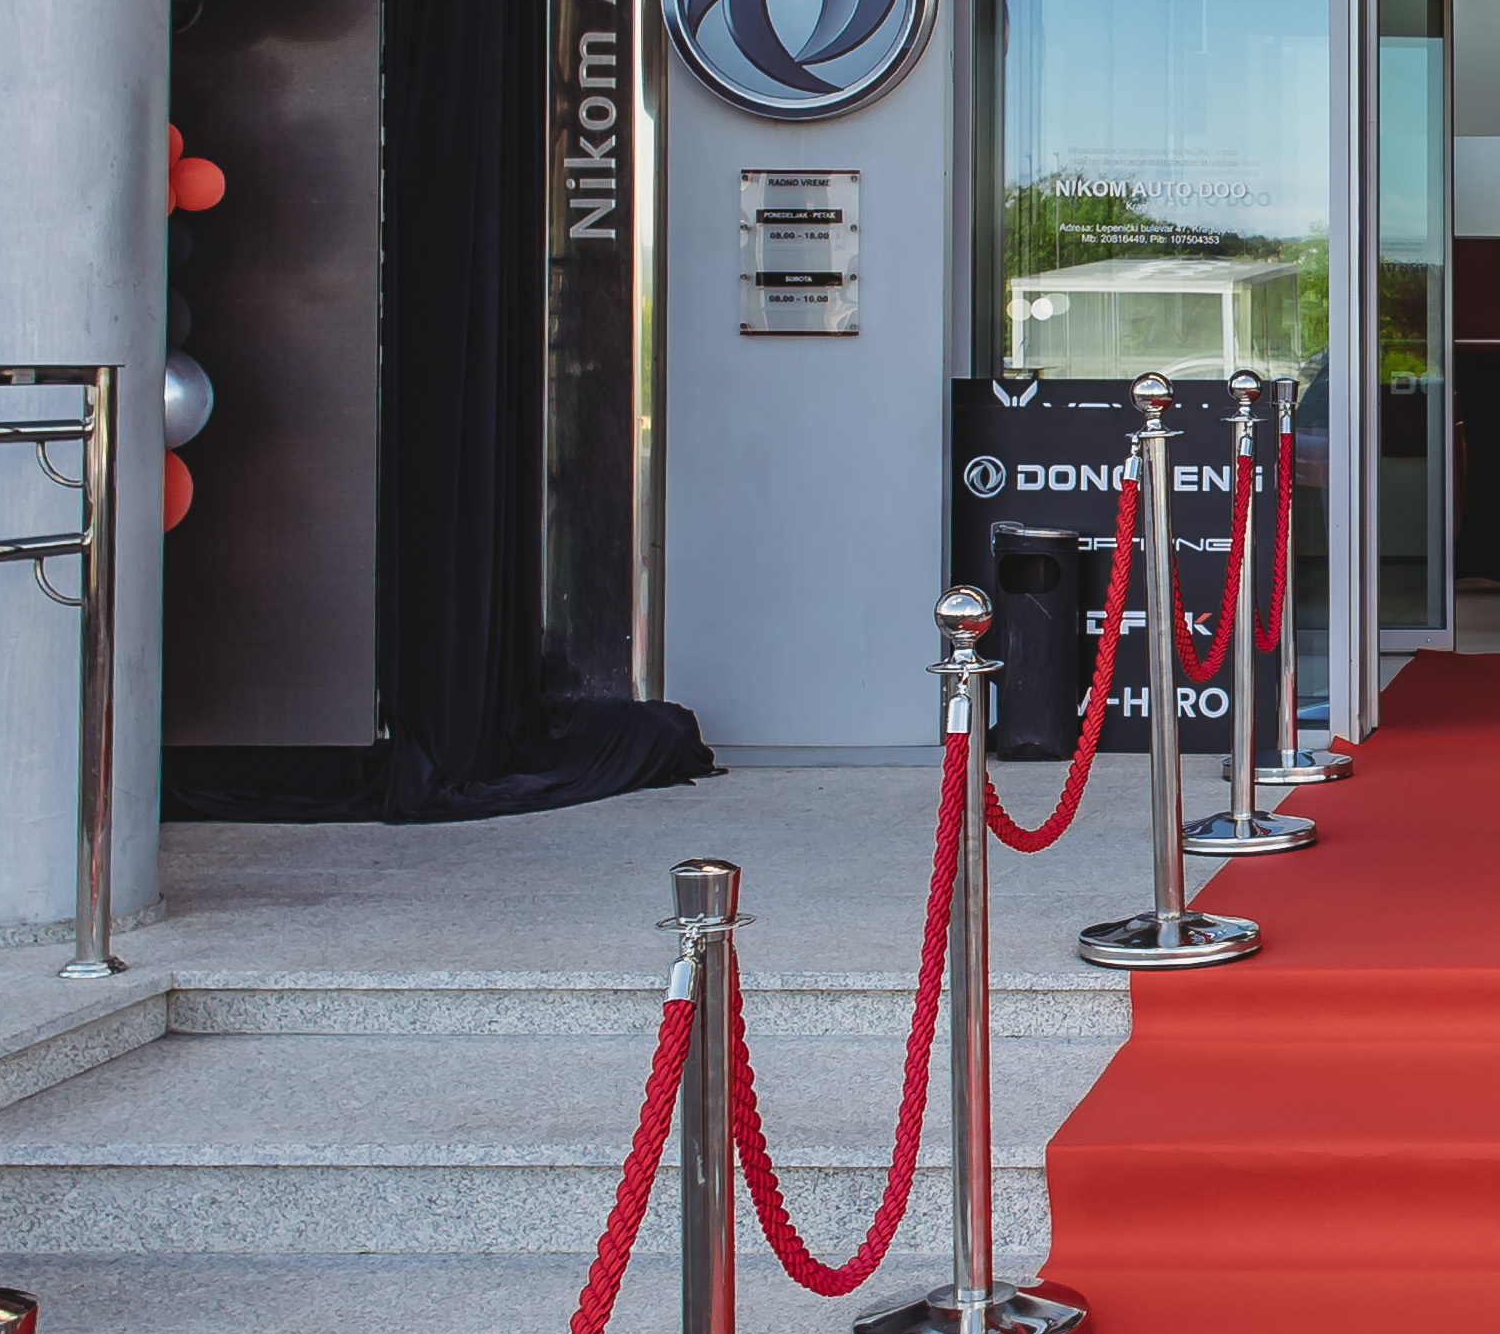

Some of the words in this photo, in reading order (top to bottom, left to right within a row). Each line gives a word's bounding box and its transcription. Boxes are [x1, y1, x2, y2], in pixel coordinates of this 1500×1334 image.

[564, 31, 617, 239] Nikom
[768, 179, 799, 187] RADNO
[1056, 179, 1127, 197] NIKOM
[1131, 181, 1192, 198] AUTO
[1200, 182, 1247, 199] DOO
